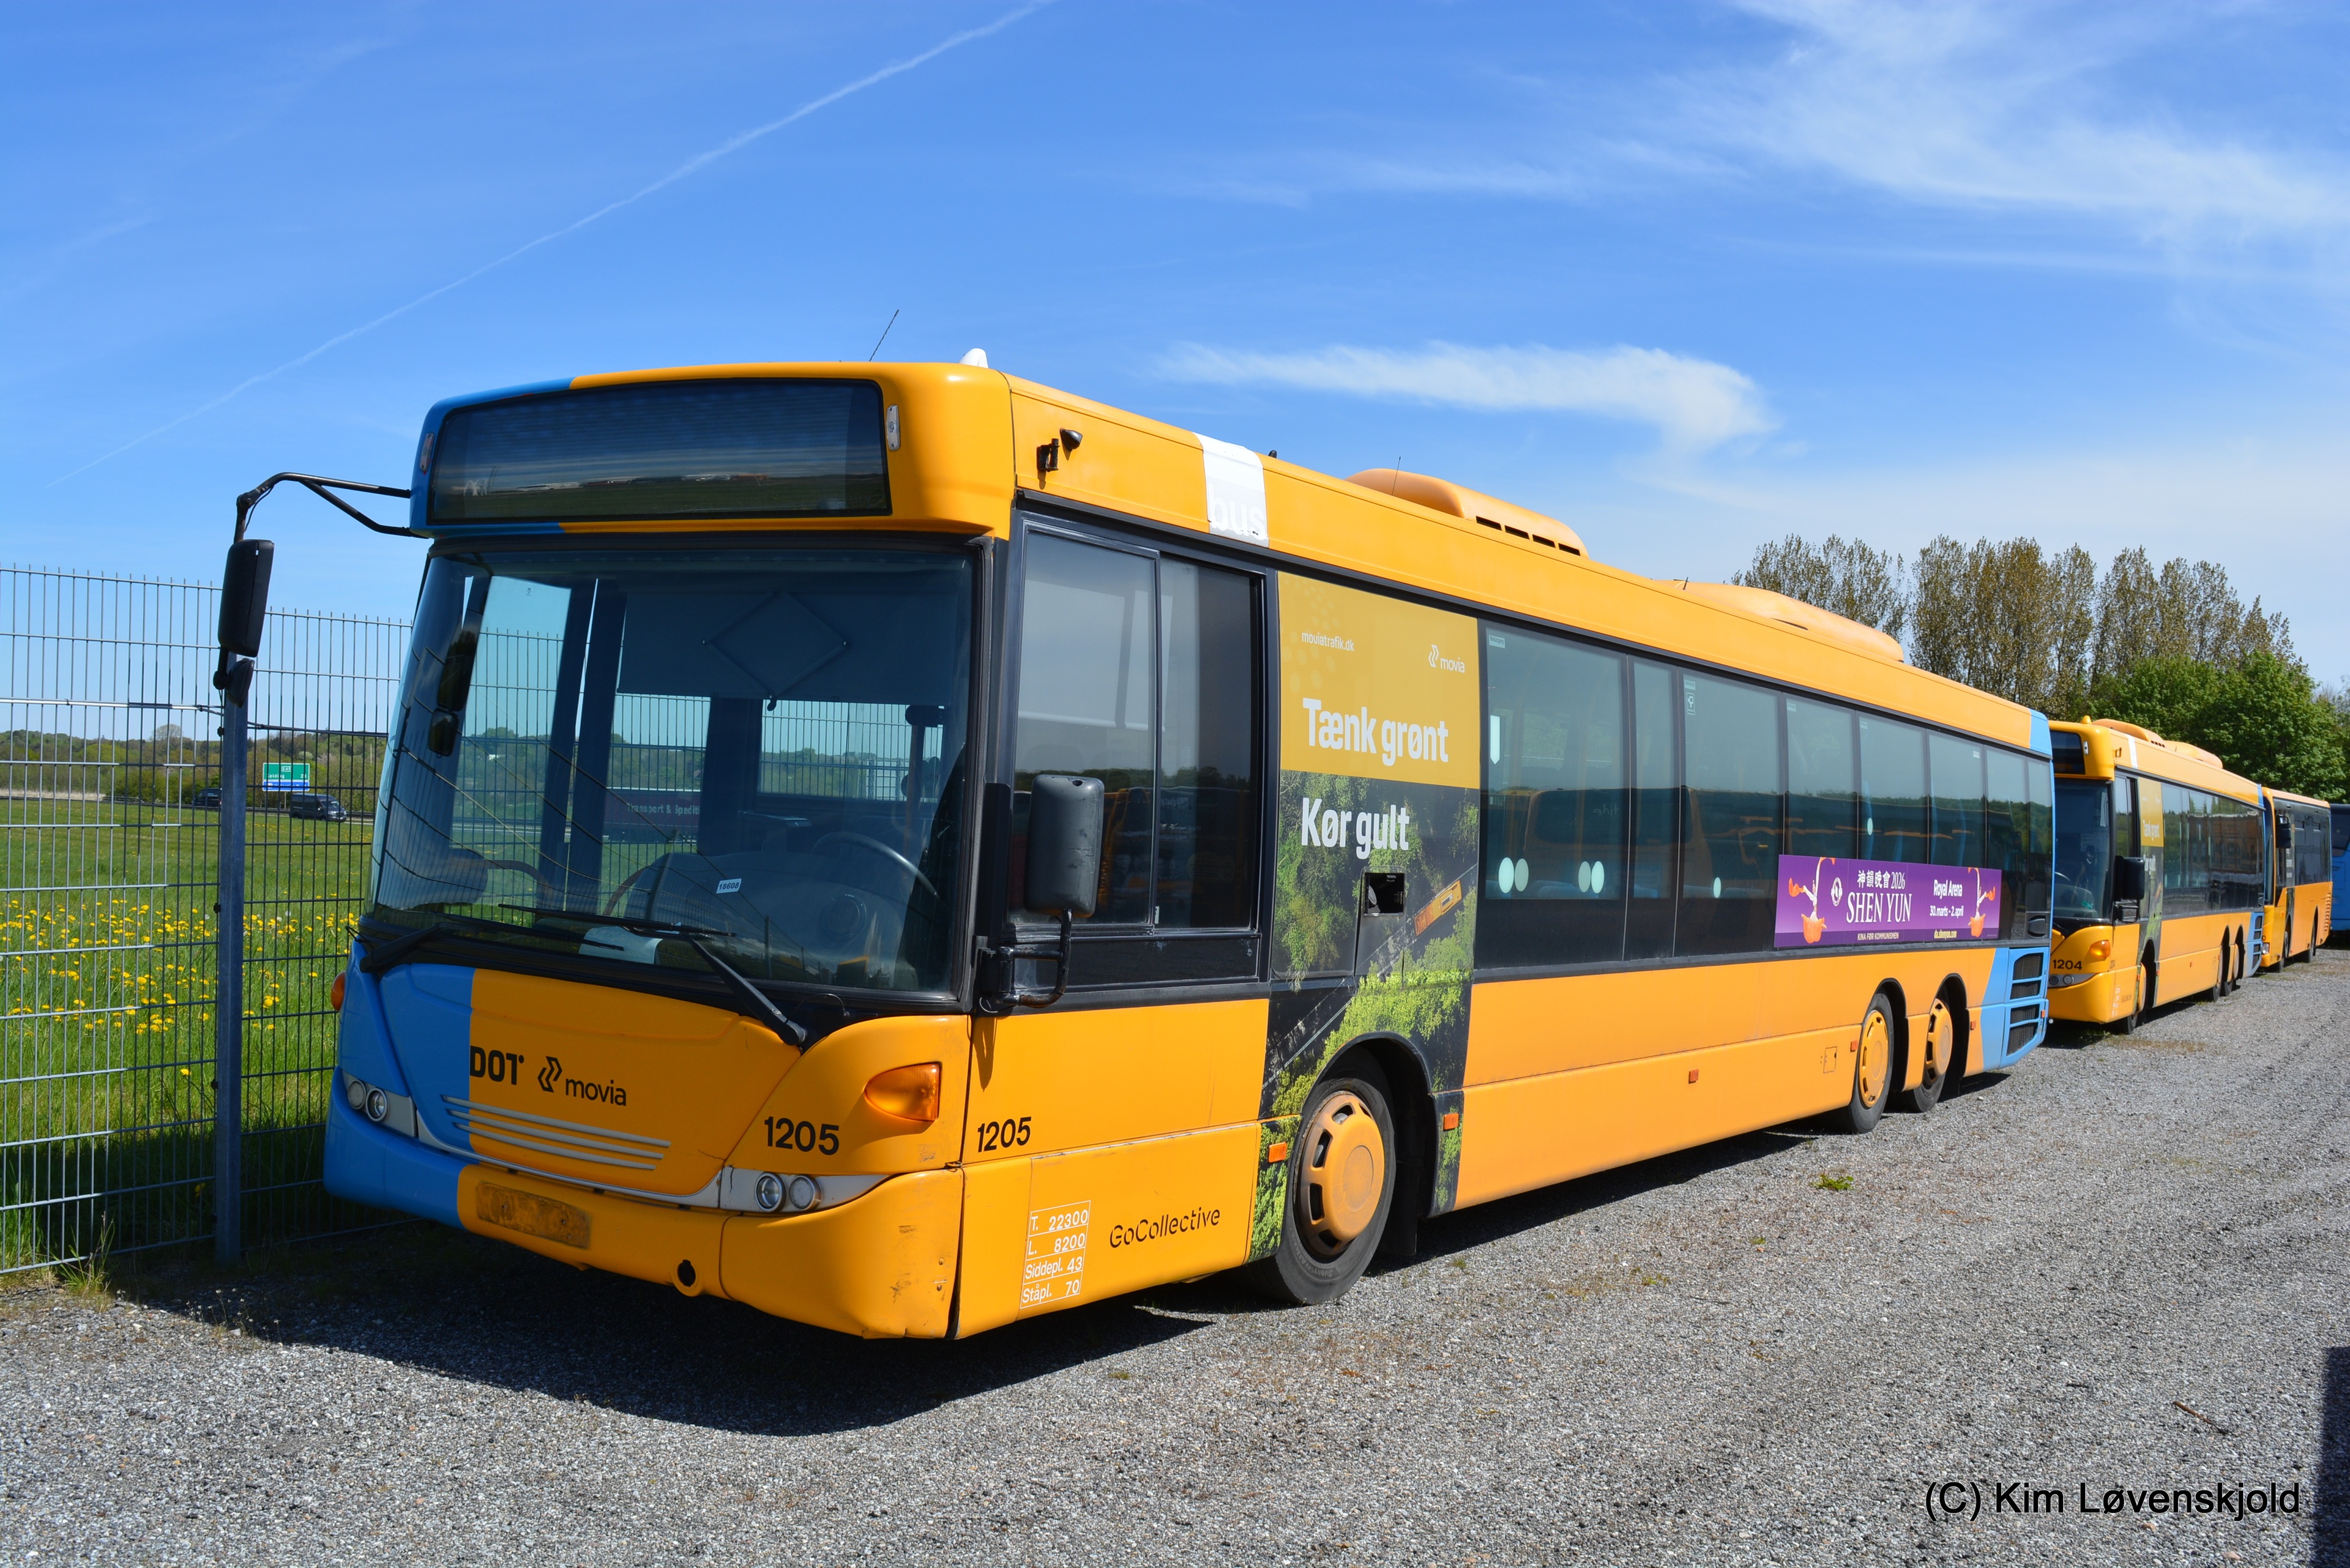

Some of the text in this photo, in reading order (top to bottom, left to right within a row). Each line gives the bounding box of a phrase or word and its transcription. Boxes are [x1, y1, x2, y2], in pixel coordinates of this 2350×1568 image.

[1208, 483, 1266, 540] bus
[1302, 632, 1354, 652] moviatrafik.dk
[1440, 657, 1465, 673] movia
[1302, 697, 1449, 766] Tænk grønt
[627, 803, 663, 815] Transport
[666, 804, 672, 814] &
[1301, 797, 1410, 859] Kør gult
[1891, 872, 1906, 889] 2026
[1934, 879, 1963, 900] Royal Arena
[1846, 892, 1912, 924] SHEN YUN
[2053, 959, 2082, 970] 1204
[470, 1045, 524, 1085] DOT
[565, 1078, 627, 1107] movia
[764, 1116, 840, 1156] 1205
[977, 1116, 1032, 1153] 1205
[1031, 1209, 1088, 1231] T. 22300
[1110, 1206, 1220, 1248] GoCollective
[1028, 1233, 1086, 1255] L. 8200
[1025, 1256, 1083, 1280] Siddepl. 43
[1022, 1279, 1080, 1303] Ståpl. 70
